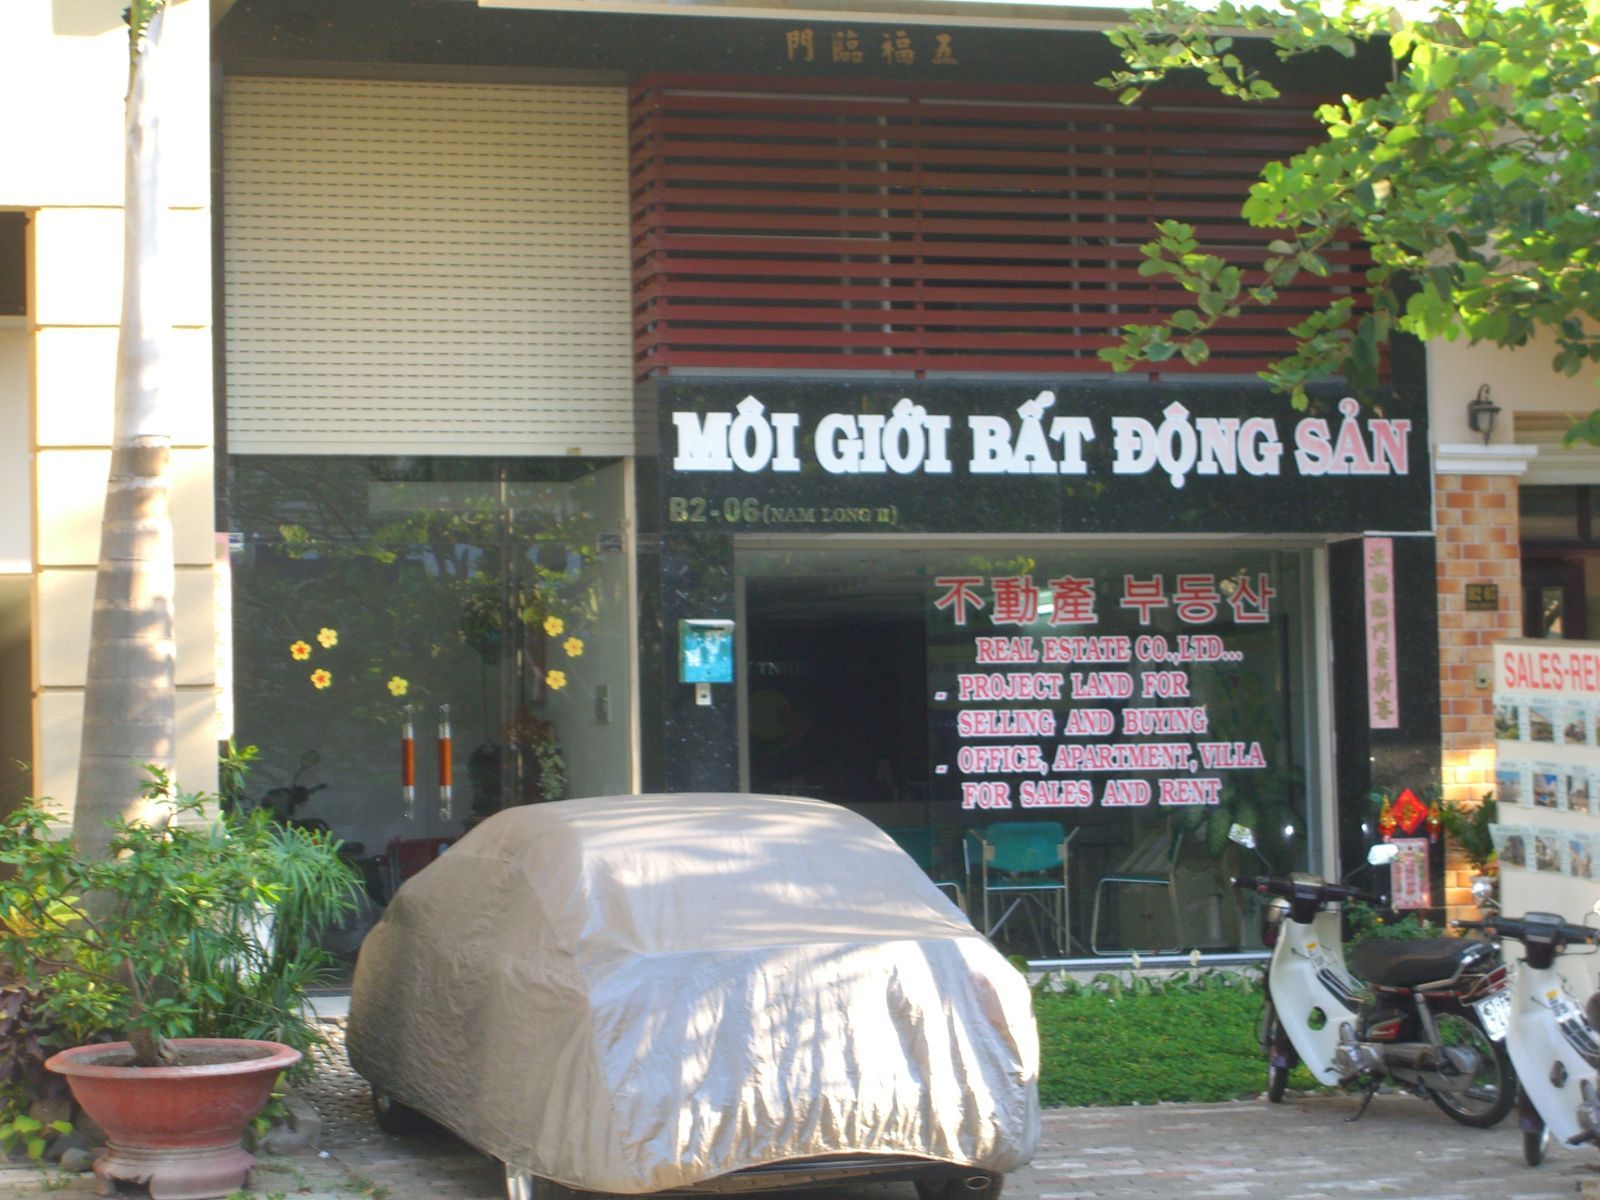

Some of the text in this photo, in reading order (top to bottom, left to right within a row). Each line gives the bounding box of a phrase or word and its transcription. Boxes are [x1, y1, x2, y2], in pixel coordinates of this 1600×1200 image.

[672, 390, 1411, 489] MÔI GIỚI BẤT ĐỘNG SẢN
[668, 497, 760, 523] B2-06
[762, 504, 815, 525] (NAM
[821, 507, 871, 523] LONG
[1120, 573, 1276, 625] 부동산
[976, 637, 1039, 664] REAL
[1042, 636, 1132, 663] ESTATE
[958, 671, 1190, 700] PROJECT LAND FOR
[957, 707, 1209, 737] SELLING AND BUYING
[957, 745, 1049, 776] OFFICE,
[962, 778, 1222, 809] FOR SALES AND RENT
